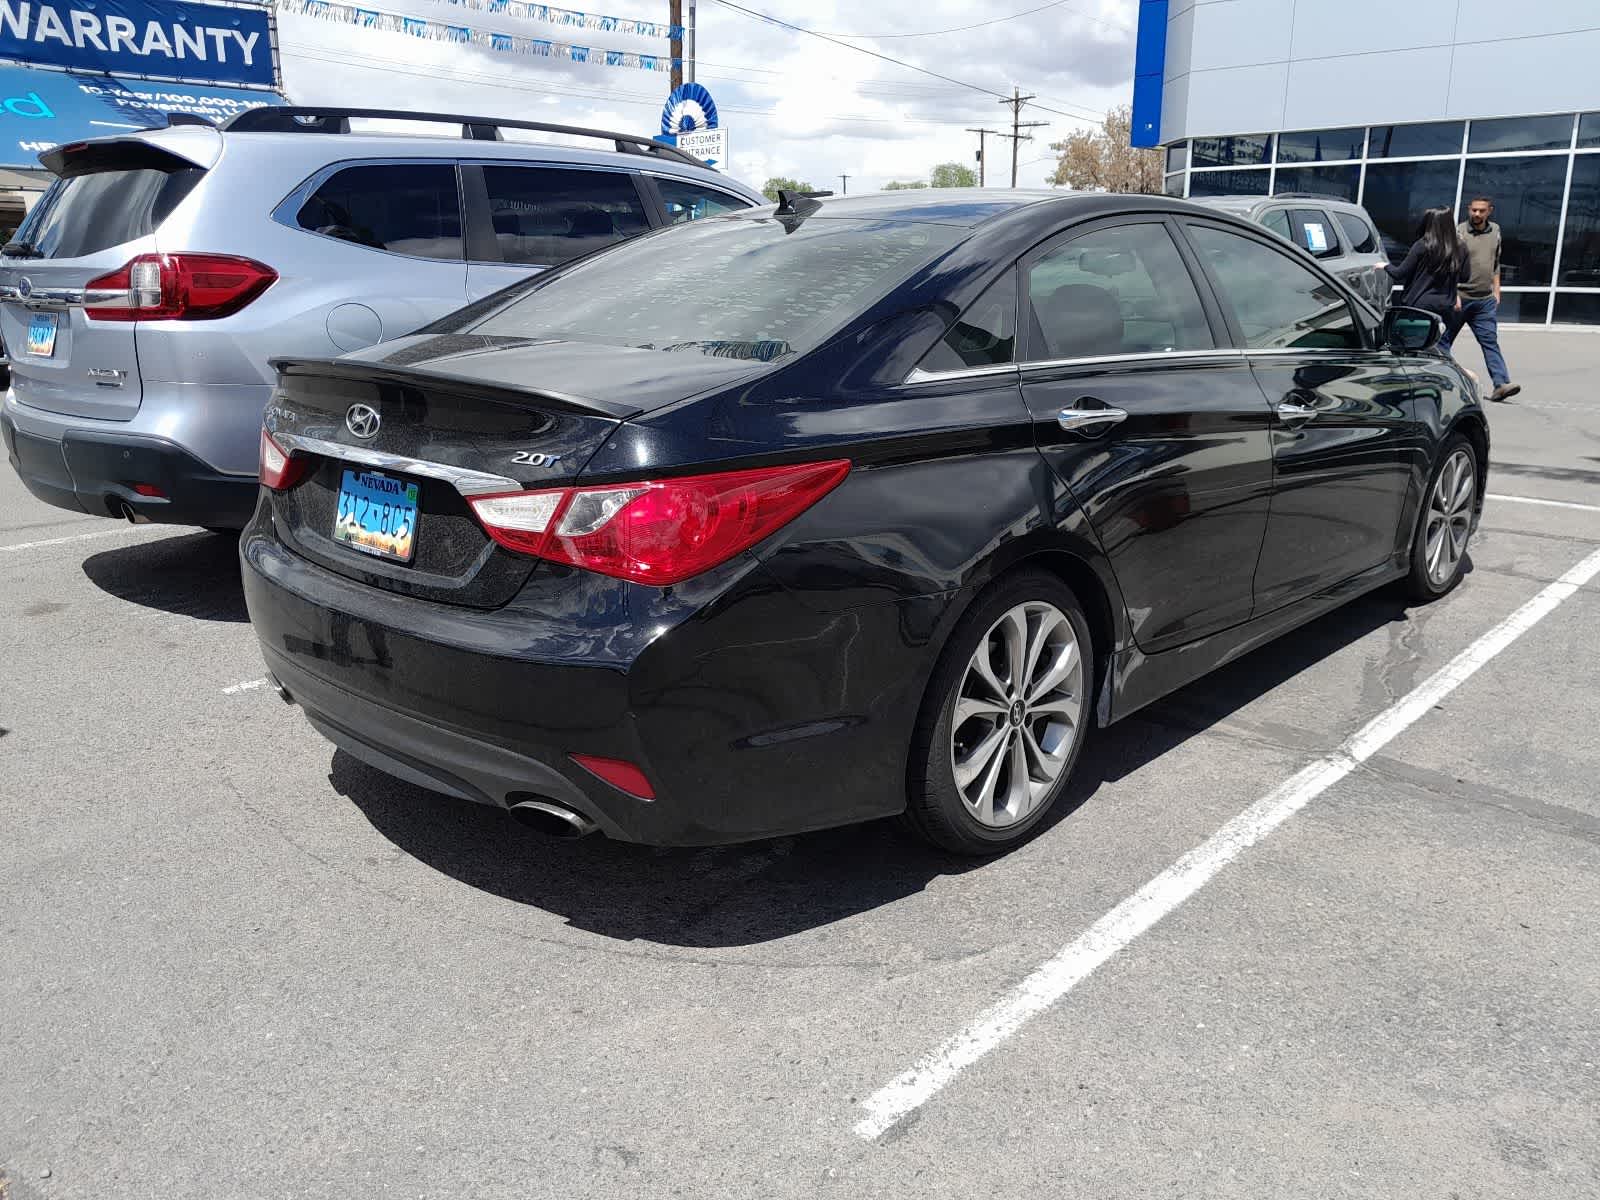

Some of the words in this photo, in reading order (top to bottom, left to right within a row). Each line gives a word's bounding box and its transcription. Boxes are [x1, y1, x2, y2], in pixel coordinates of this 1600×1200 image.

[680, 133, 721, 146] CUSTOMER
[685, 145, 721, 157] NTRANCE
[360, 475, 400, 496] NEVADA
